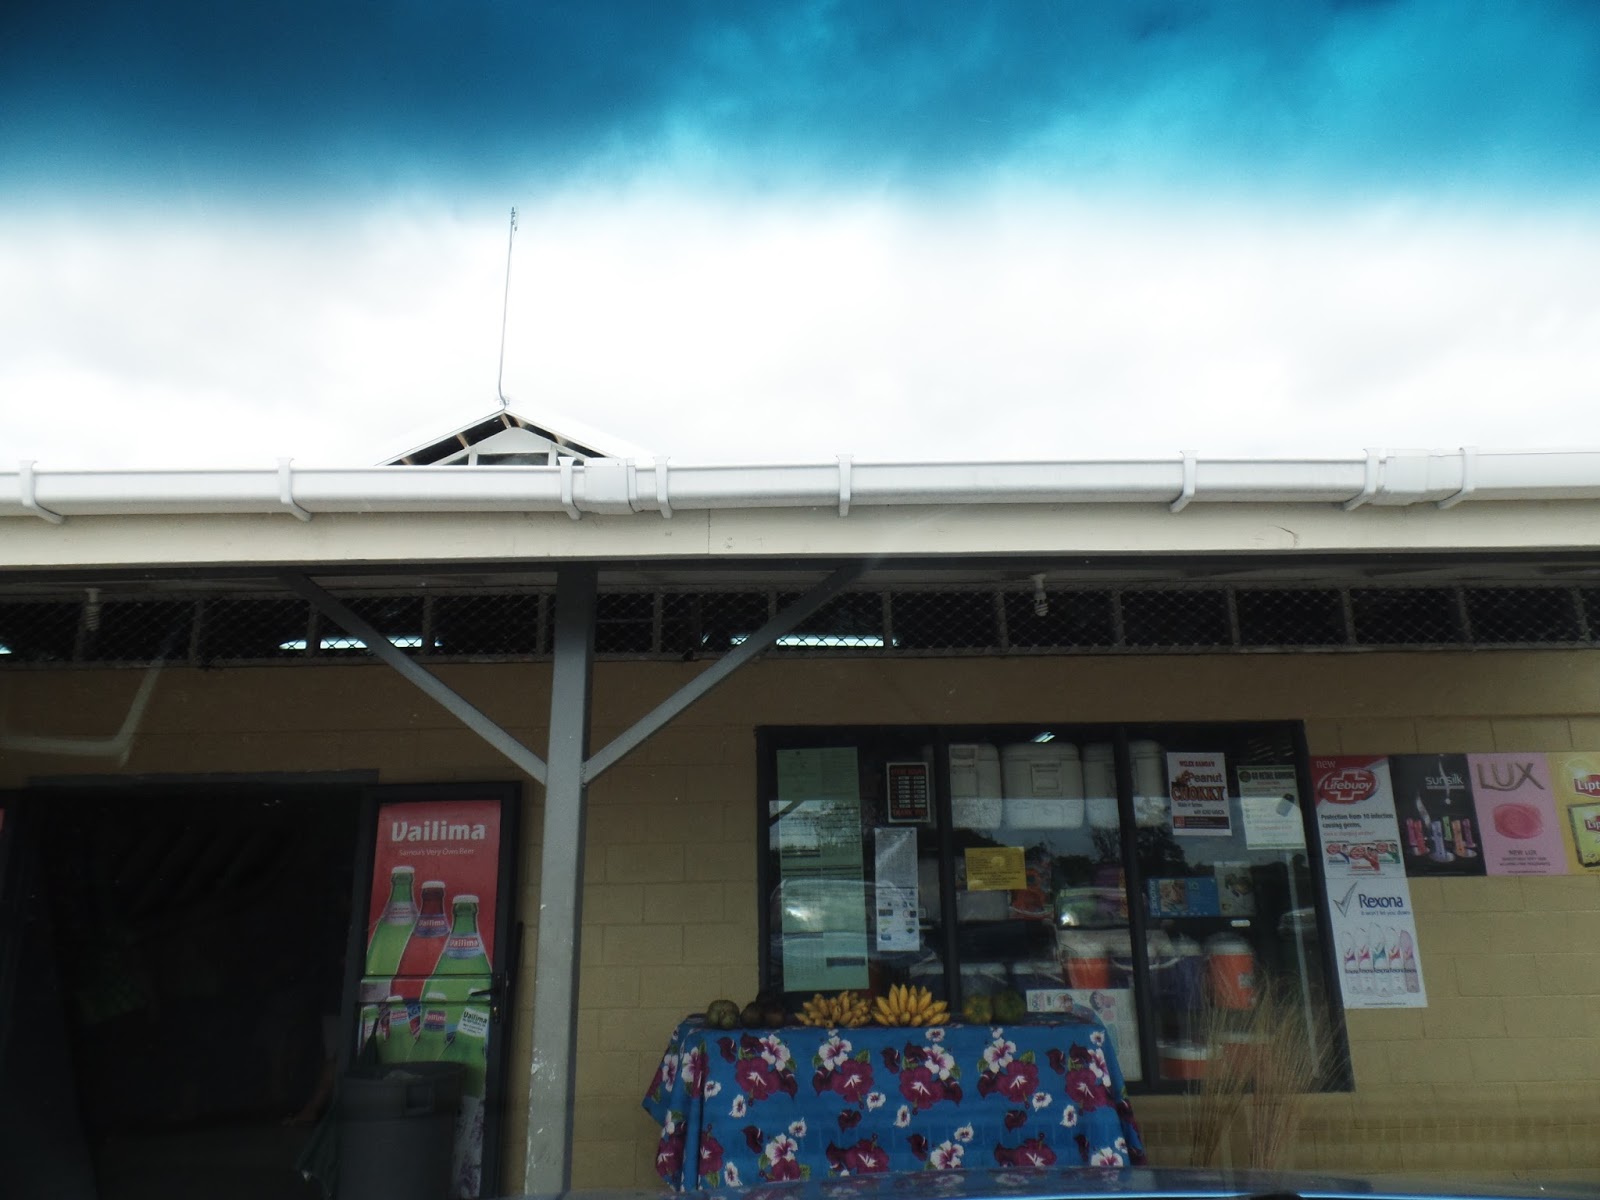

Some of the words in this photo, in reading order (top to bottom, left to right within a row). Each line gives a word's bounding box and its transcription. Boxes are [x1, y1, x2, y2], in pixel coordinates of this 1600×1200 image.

[1316, 760, 1335, 769] new
[1188, 771, 1223, 783] Peanut
[1425, 774, 1464, 786] sunsilk
[1477, 762, 1545, 791] LUX
[1324, 780, 1372, 792] Lifebuoy
[392, 820, 486, 842] Vailima
[1358, 893, 1404, 909] Rexona
